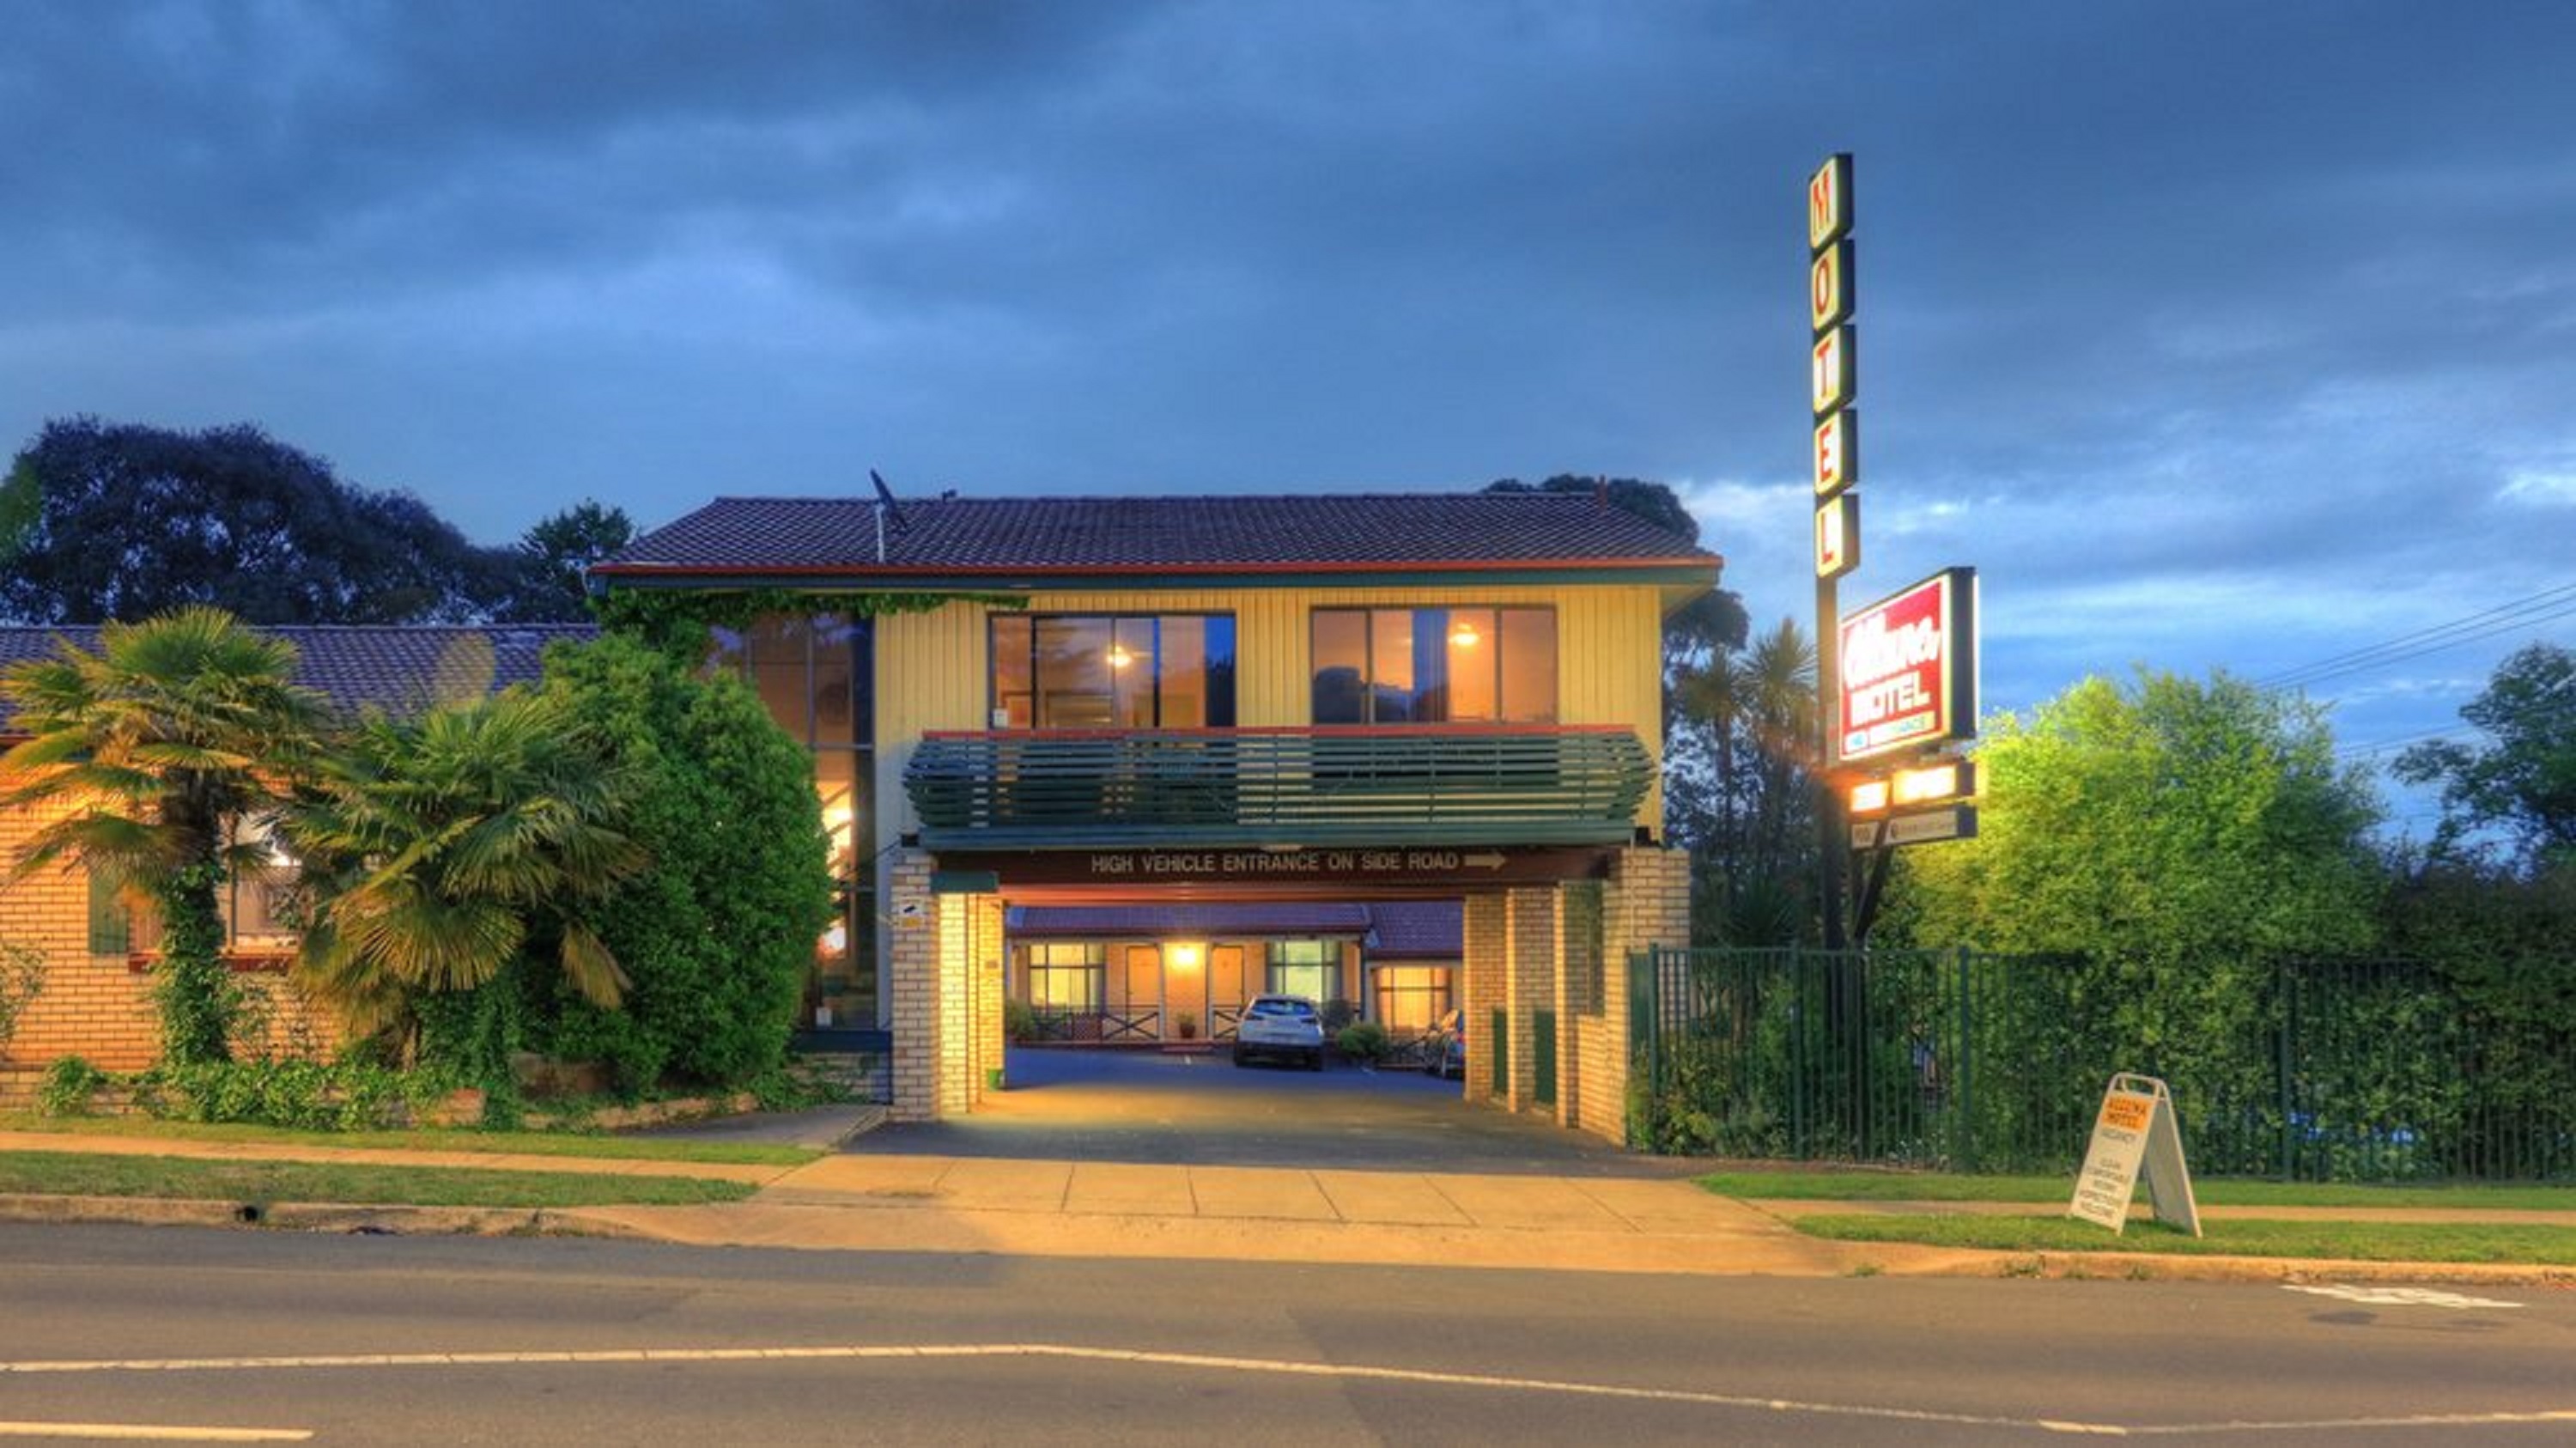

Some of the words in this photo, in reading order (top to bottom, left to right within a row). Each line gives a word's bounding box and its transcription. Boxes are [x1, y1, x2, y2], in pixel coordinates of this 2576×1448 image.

[1813, 167, 1835, 564] MOTEL
[1850, 670, 1930, 727] MOTEL
[1091, 854, 1134, 873] HIGH
[1142, 854, 1216, 873] VEHICLE
[1223, 852, 1320, 873] ENTRANCE
[1329, 852, 1354, 871] ON
[1362, 852, 1400, 871] SIDE
[1408, 851, 1459, 871] ROAD
